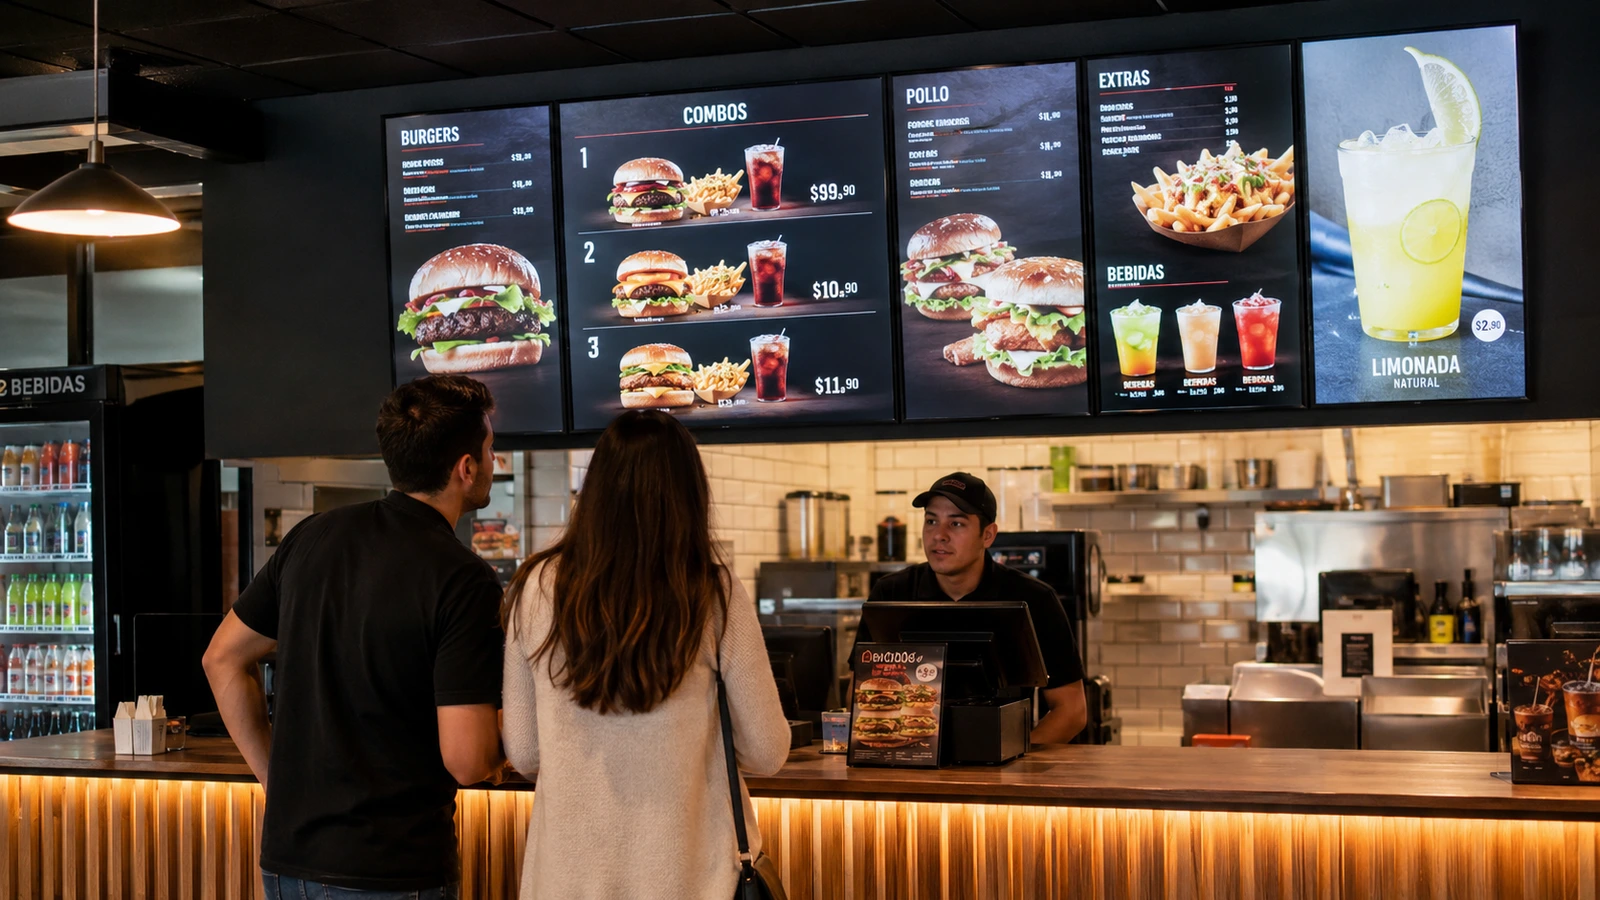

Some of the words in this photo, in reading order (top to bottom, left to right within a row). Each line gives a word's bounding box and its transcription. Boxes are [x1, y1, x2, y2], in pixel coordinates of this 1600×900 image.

[1098, 70, 1151, 89] EXTRAS
[906, 86, 950, 105] POLLO
[683, 102, 748, 125] COMBOS
[401, 126, 460, 146] BURGERS
[579, 146, 588, 169] 1
[583, 240, 596, 264] 2
[1107, 263, 1165, 282] BEBIDAS
[1475, 319, 1502, 331] $2.90
[587, 336, 600, 359] 3
[1372, 355, 1461, 377] LIMONADA
[11, 374, 86, 396] BEBIDAS
[1393, 377, 1440, 389] NATURAL
